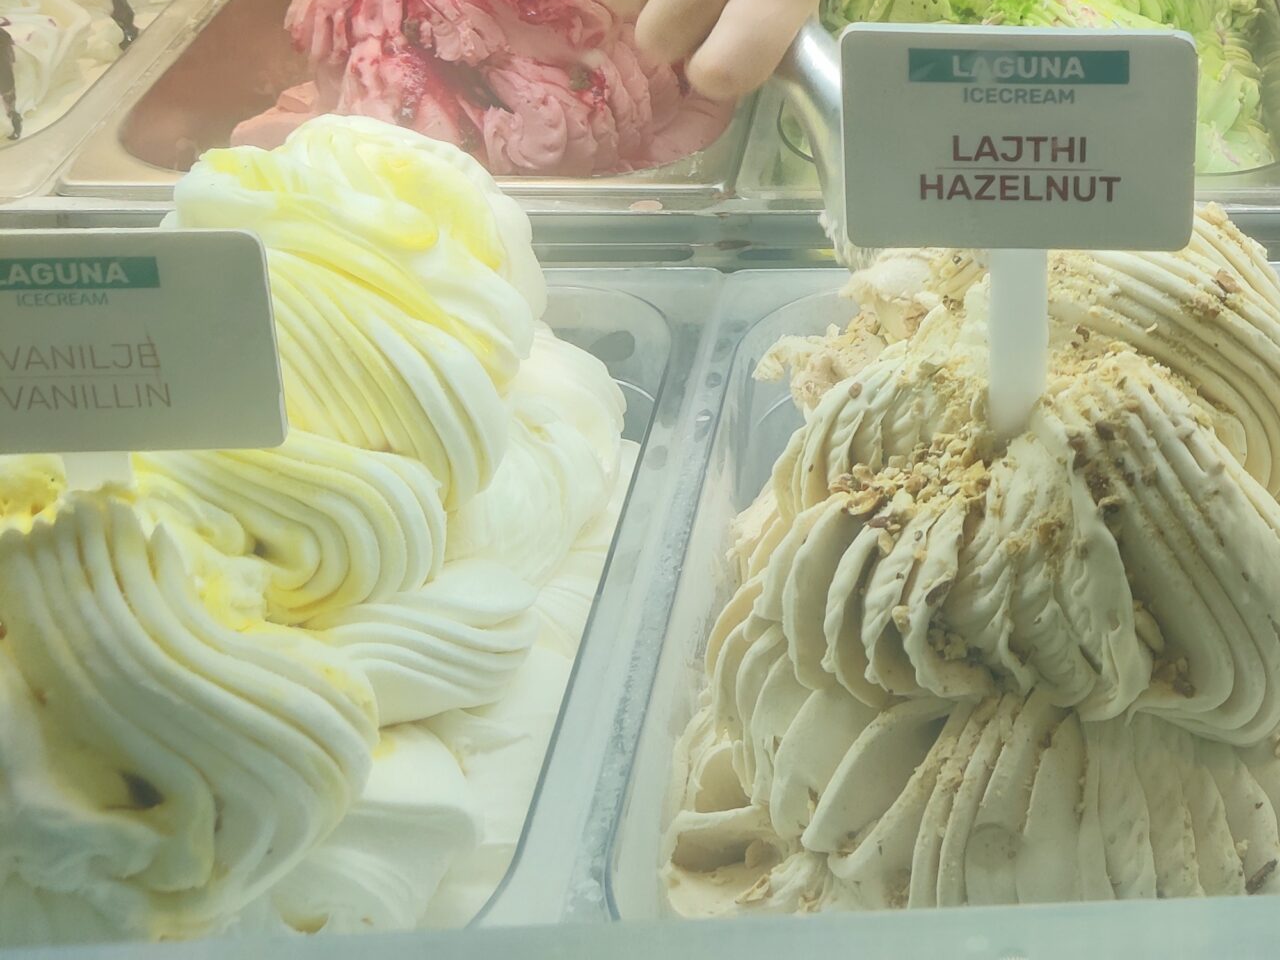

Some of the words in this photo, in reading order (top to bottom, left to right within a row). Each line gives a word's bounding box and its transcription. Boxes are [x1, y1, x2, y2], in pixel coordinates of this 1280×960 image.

[952, 55, 1086, 79] LAGUNA
[963, 87, 1075, 105] ICECREAM
[952, 135, 1087, 163] LAJTHI
[919, 174, 1121, 202] HAZELNUT
[16, 292, 109, 307] ICECREAM
[0, 383, 172, 411] VANILLIN
